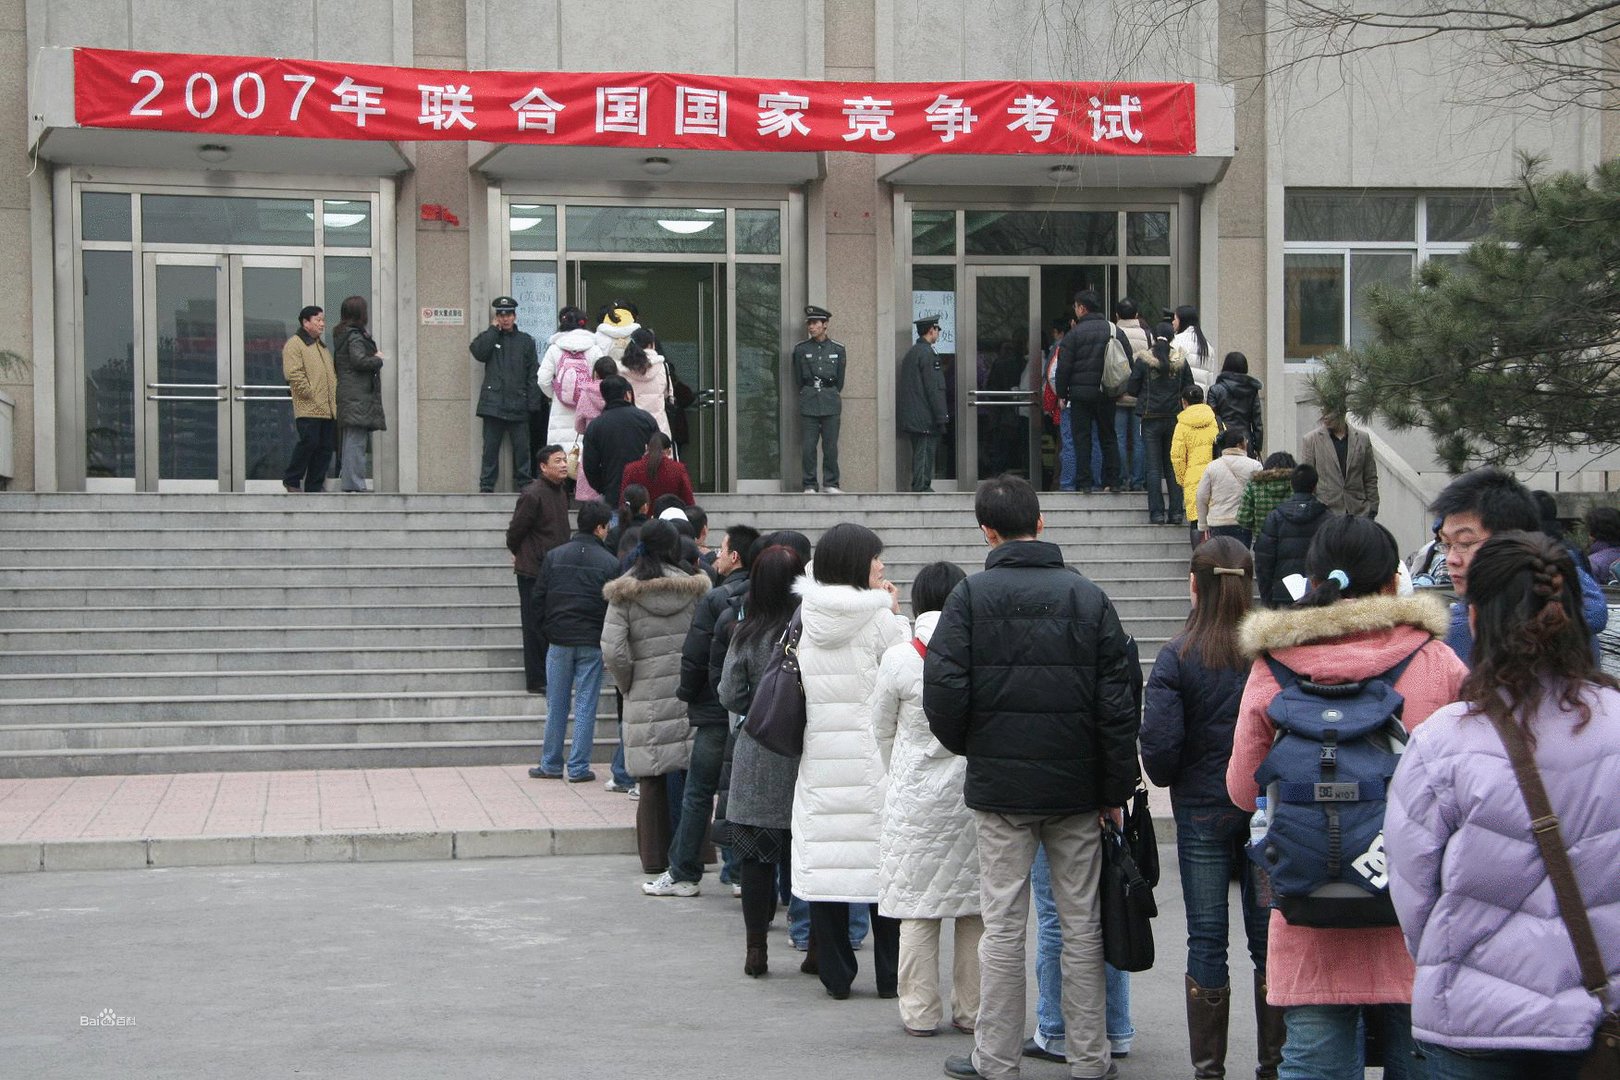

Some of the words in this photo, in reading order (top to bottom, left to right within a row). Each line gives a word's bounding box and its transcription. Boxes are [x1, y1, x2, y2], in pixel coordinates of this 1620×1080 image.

[130, 69, 1144, 144] 2007年联合国国家竞争考试
